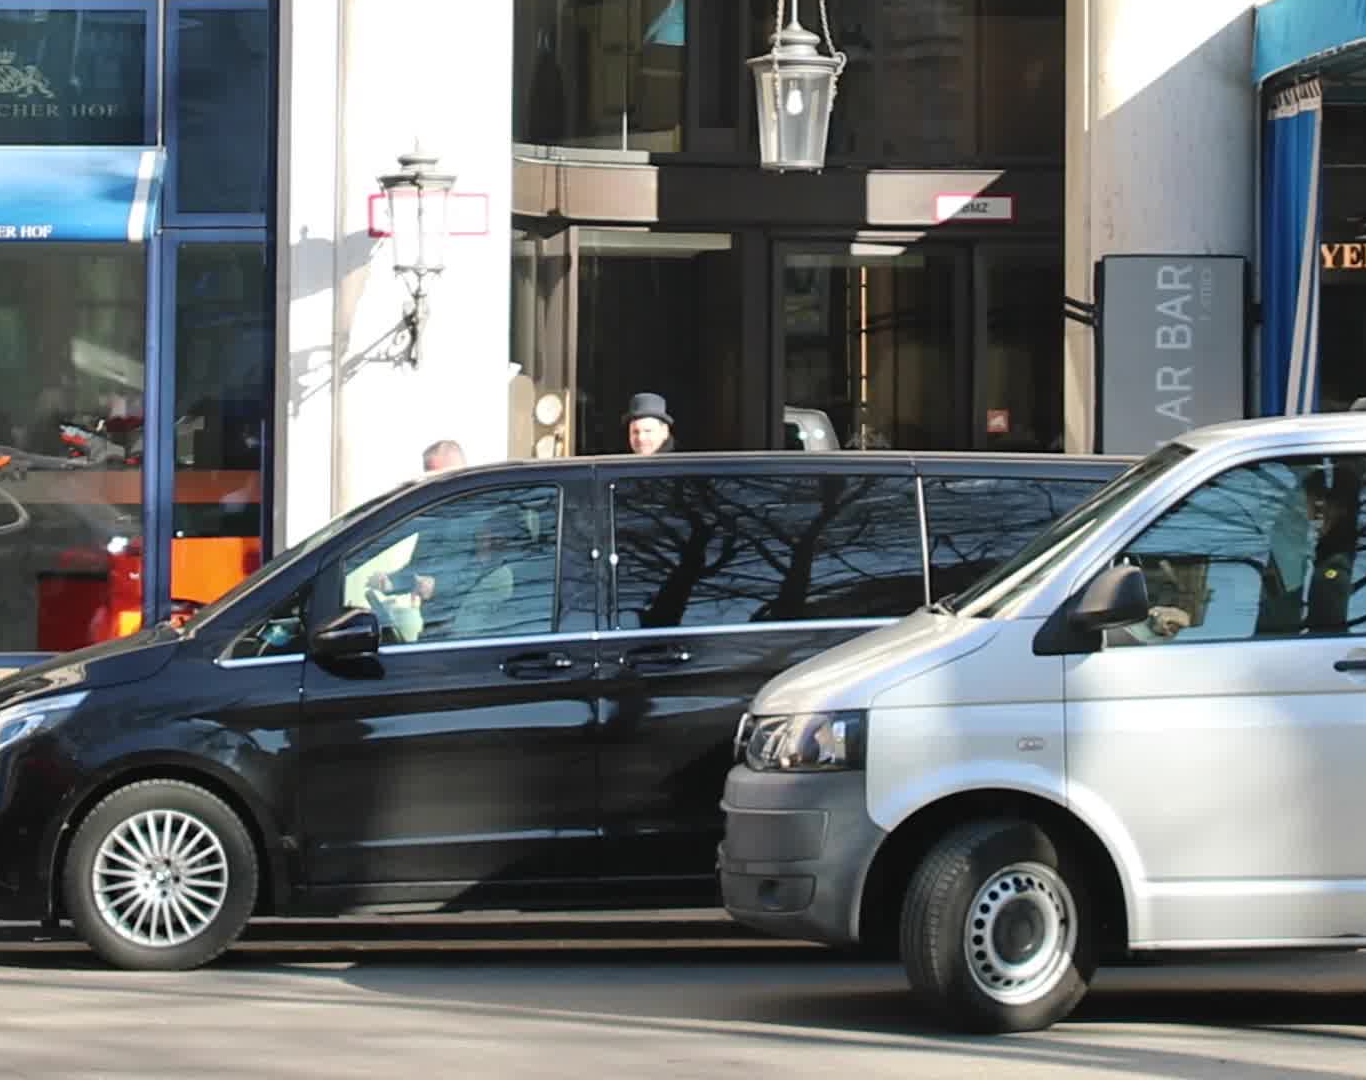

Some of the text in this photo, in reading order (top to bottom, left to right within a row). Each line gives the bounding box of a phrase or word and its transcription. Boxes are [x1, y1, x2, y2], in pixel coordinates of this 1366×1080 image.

[71, 103, 119, 118] HOF
[20, 224, 53, 238] HOF
[1155, 264, 1196, 351] BAR
